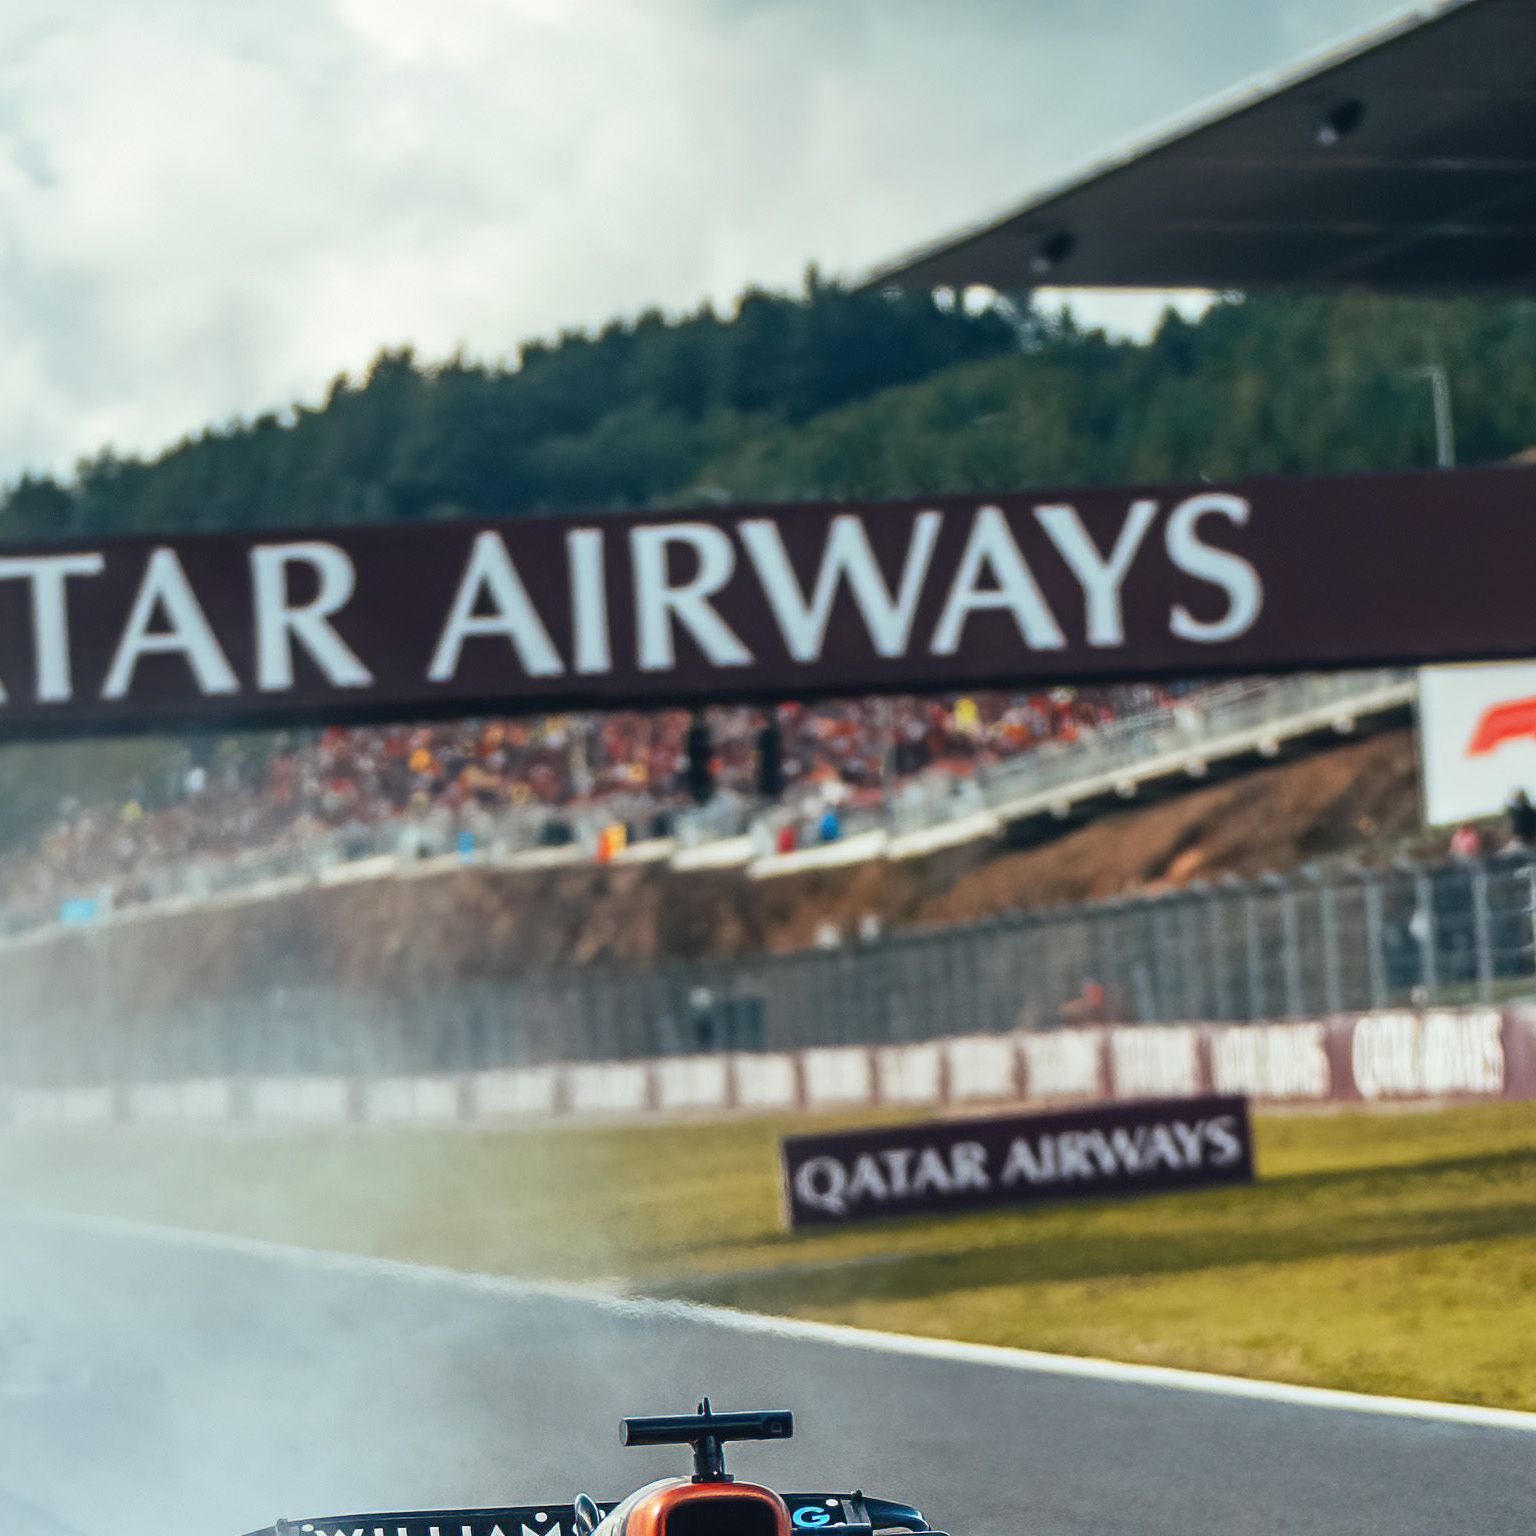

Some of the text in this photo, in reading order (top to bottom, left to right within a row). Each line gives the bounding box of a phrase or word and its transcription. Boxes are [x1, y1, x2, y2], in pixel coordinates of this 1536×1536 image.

[425, 492, 1267, 682] AIRWAYS
[793, 1114, 1243, 1215] QATAR AIRWAYS
